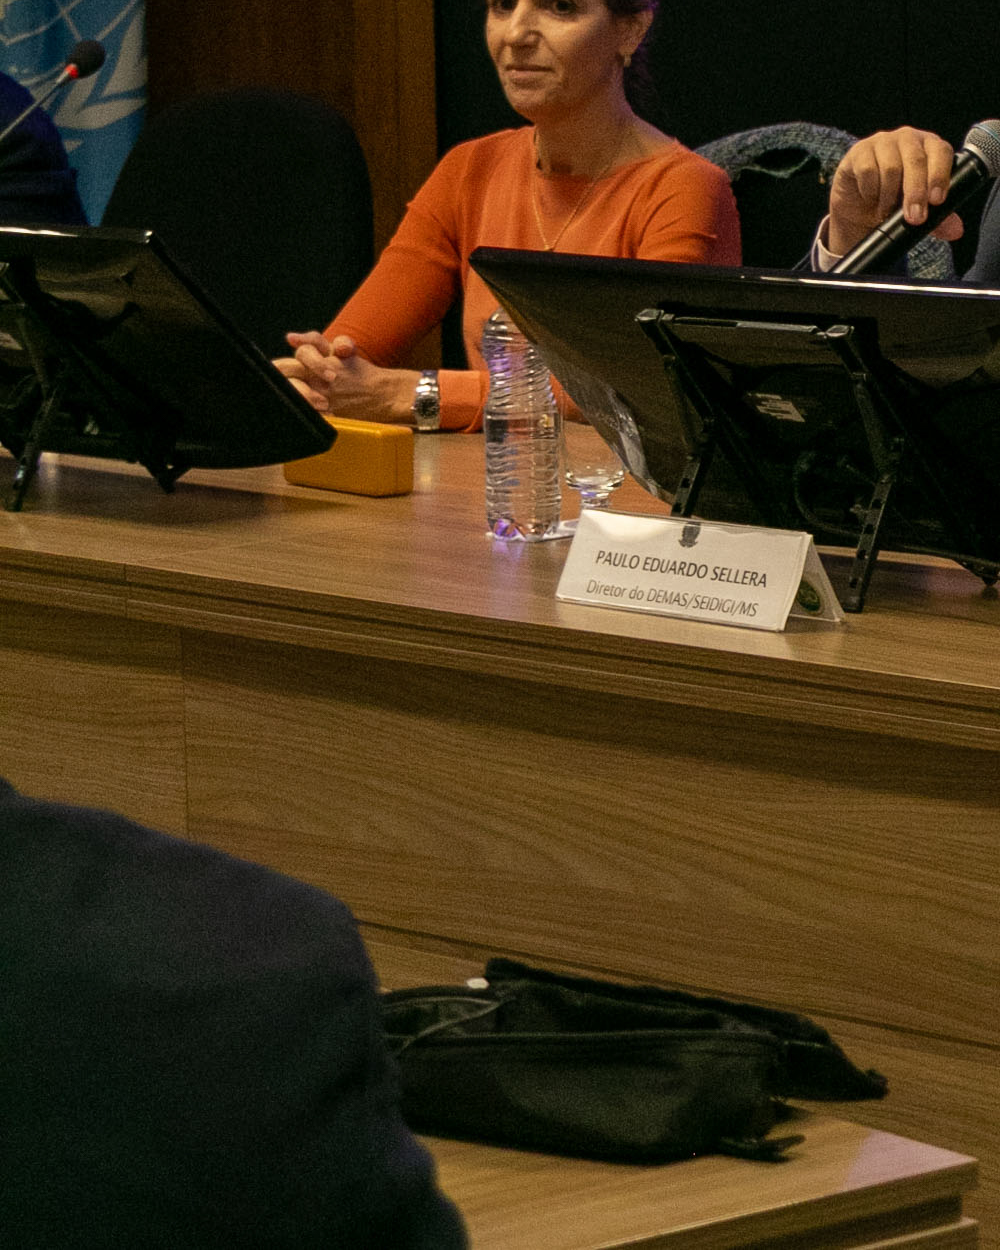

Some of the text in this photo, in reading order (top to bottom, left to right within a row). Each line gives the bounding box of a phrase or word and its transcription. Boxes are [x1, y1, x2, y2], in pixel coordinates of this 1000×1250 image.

[595, 550, 768, 588] PAULO EDUARDO SELLERA
[585, 579, 760, 617] Diretor do DEMAS/SEIDIGI/MS
